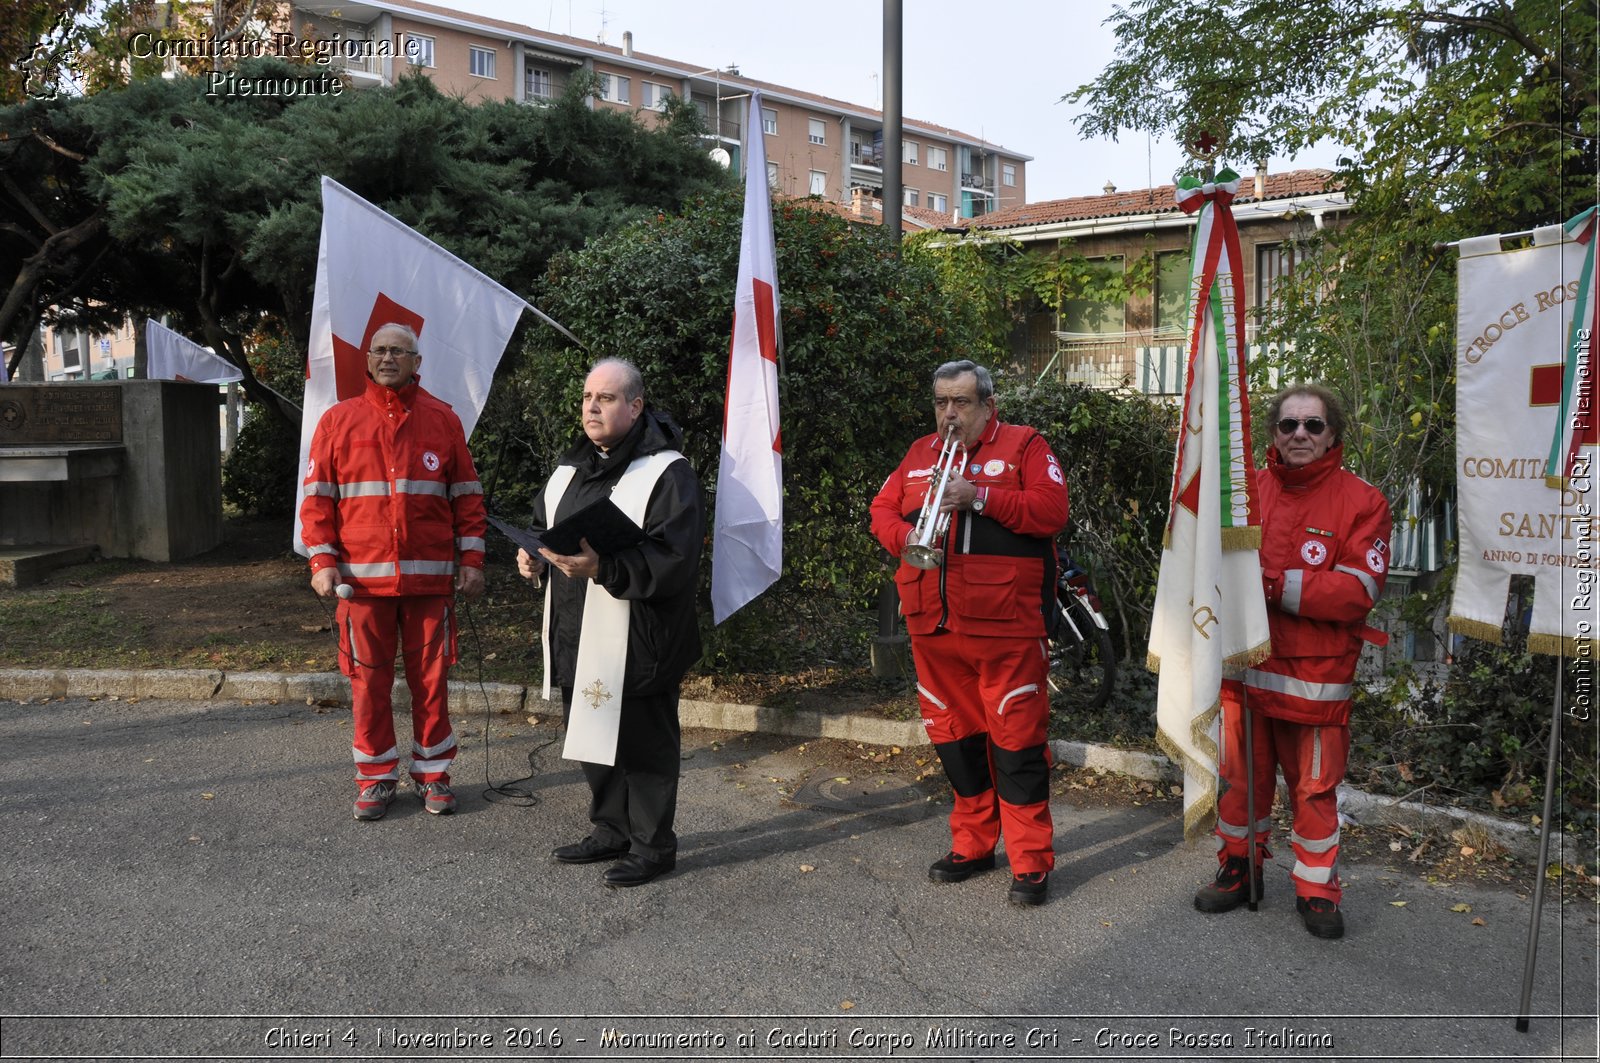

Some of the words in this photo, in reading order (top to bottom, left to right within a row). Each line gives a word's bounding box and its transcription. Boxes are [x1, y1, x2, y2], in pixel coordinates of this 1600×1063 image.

[1217, 273, 1237, 327] CHIERI
[1465, 302, 1530, 364] CROCE
[1534, 280, 1580, 313] ROS
[1223, 333, 1238, 349] DI
[1228, 428, 1251, 518] COMITATO
[1483, 550, 1521, 563] ANNO
[1527, 552, 1538, 564] DI
